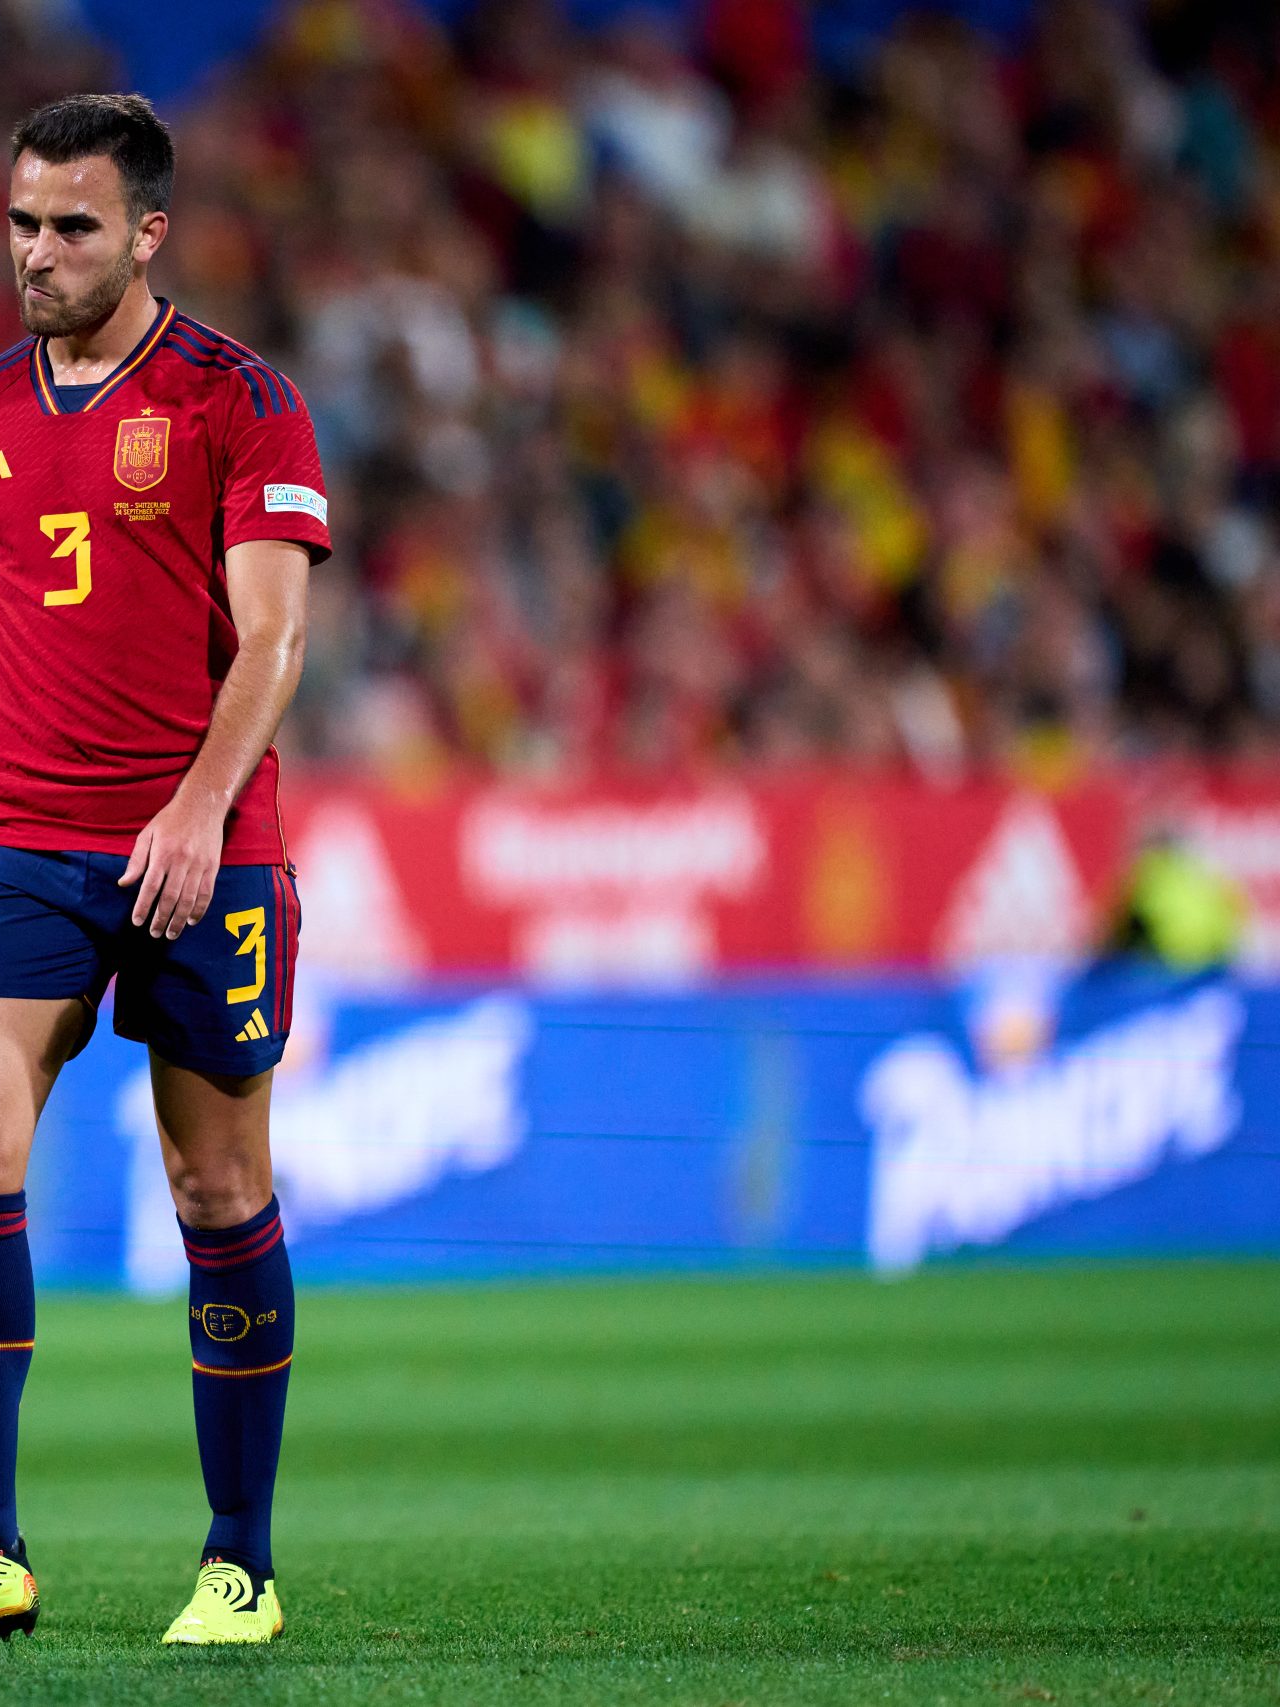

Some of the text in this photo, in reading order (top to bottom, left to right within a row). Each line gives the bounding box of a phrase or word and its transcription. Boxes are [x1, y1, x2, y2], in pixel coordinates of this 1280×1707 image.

[39, 511, 92, 607] 3
[225, 906, 266, 1005] 3
[256, 1309, 277, 1325] 09
